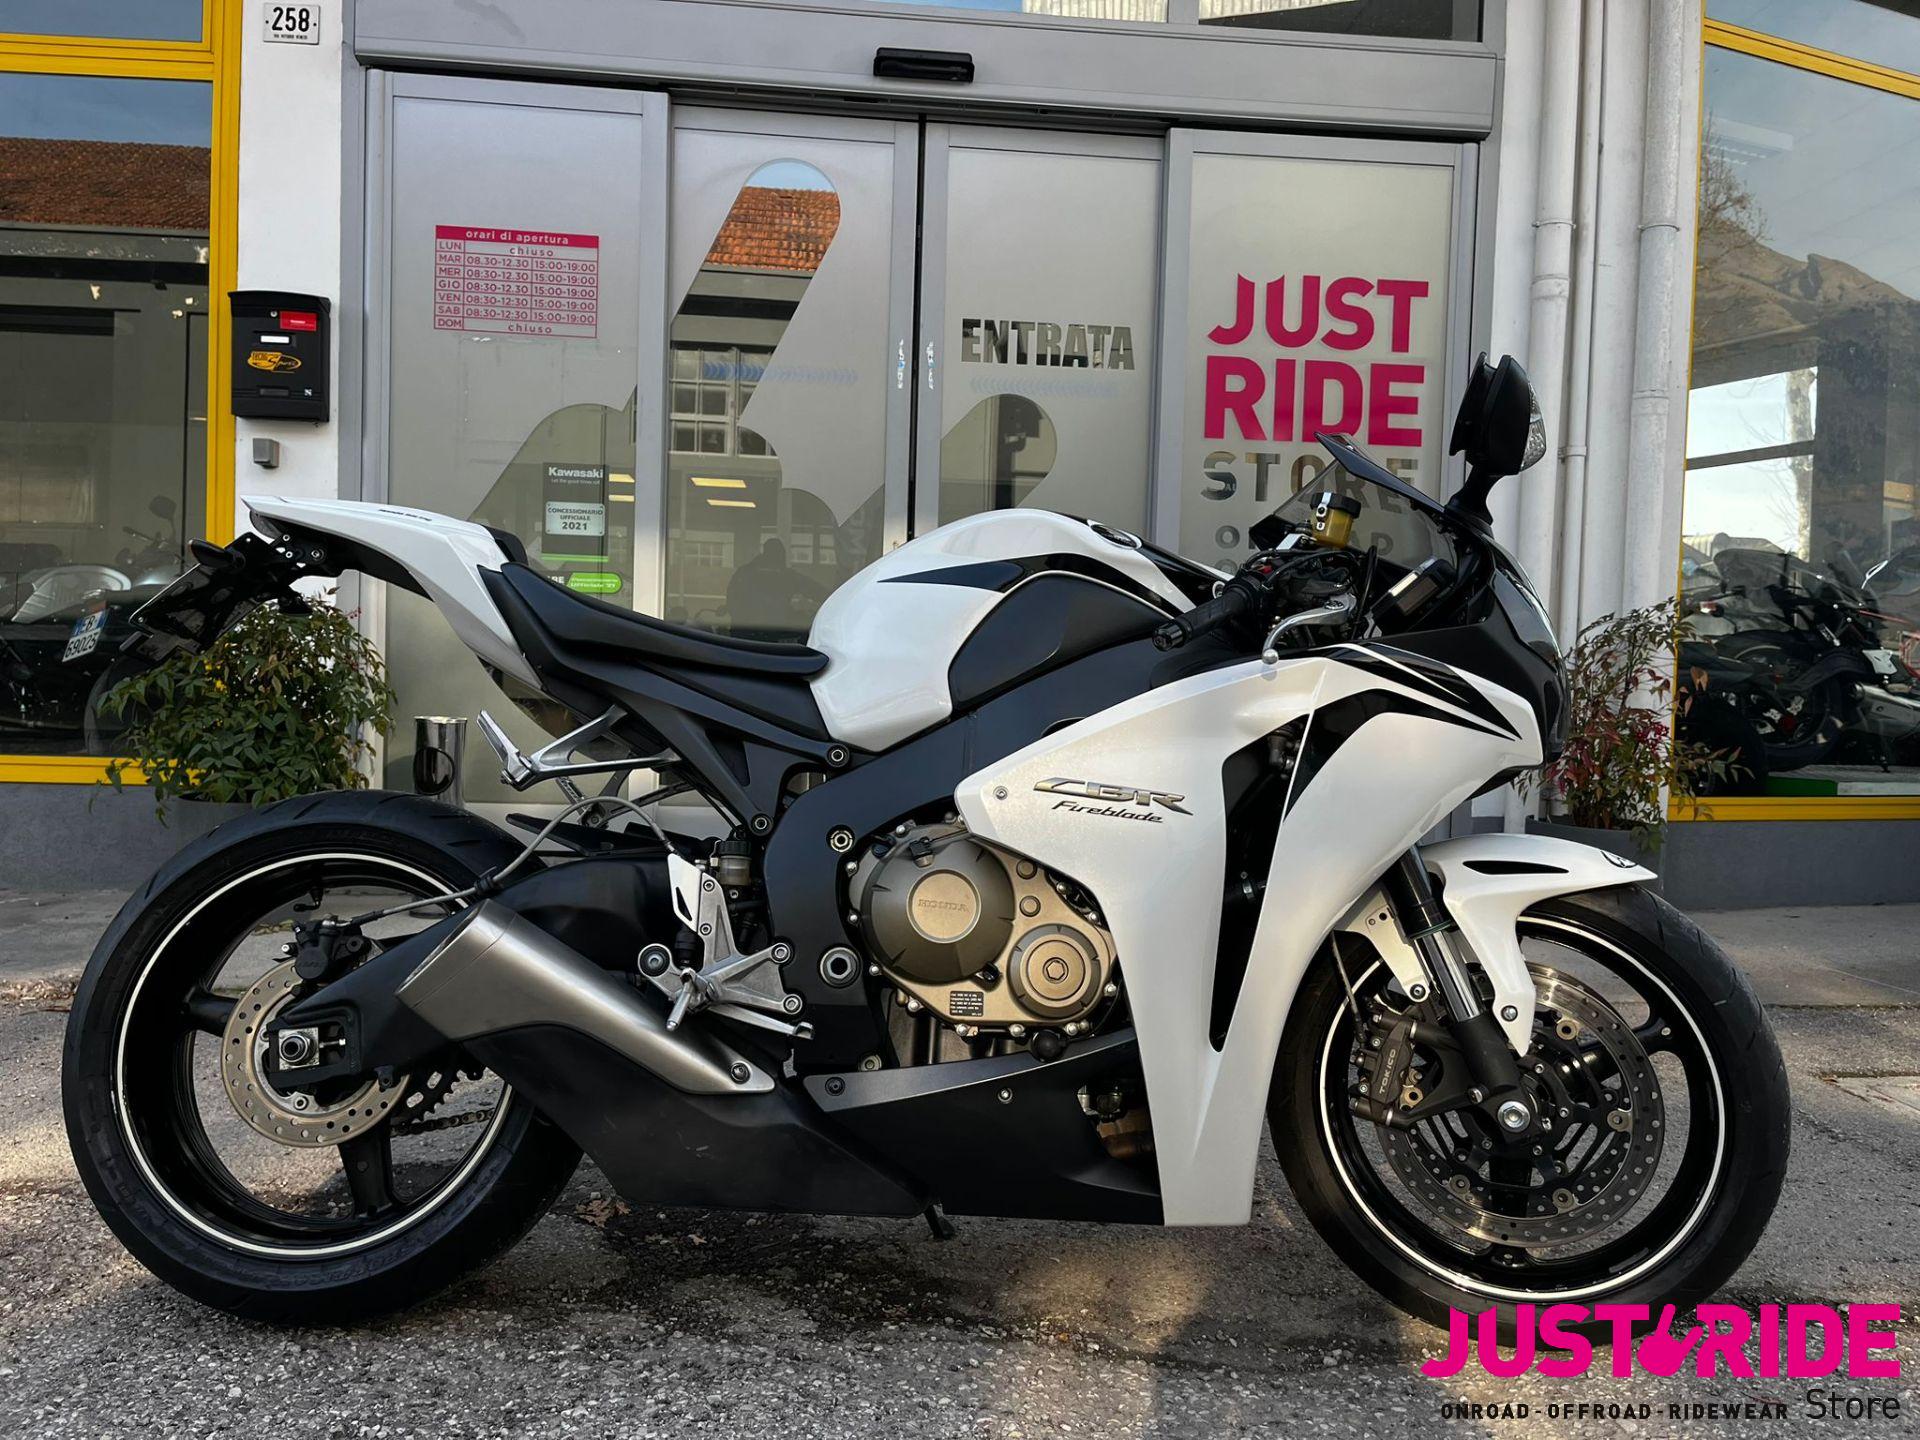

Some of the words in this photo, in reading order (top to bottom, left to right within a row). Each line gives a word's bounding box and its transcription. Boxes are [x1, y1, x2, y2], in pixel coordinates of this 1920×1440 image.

[272, 6, 310, 32] 258
[466, 230, 495, 239] orari
[500, 231, 511, 241] di
[516, 233, 569, 245] apertura
[439, 240, 461, 250] LUN
[509, 246, 554, 257] chiuso
[439, 253, 461, 263] MAR
[439, 266, 461, 276] MER
[438, 279, 460, 289] GIO
[438, 292, 461, 302] VEN
[438, 305, 460, 315] SAB
[1207, 273, 1429, 353] JUST
[437, 318, 461, 328] DOM
[508, 323, 552, 334] chiuso
[961, 318, 1135, 370] ENTRATA
[1204, 355, 1425, 447] RIDE
[548, 466, 604, 478] Kawasaki
[547, 507, 604, 516] CONCESSIONARIO
[562, 521, 588, 530] 2021
[1033, 777, 1194, 816] CBR
[1052, 800, 1164, 823] Fireblade
[918, 899, 969, 912] HONDA
[1379, 1048, 1397, 1094] TOKICO
